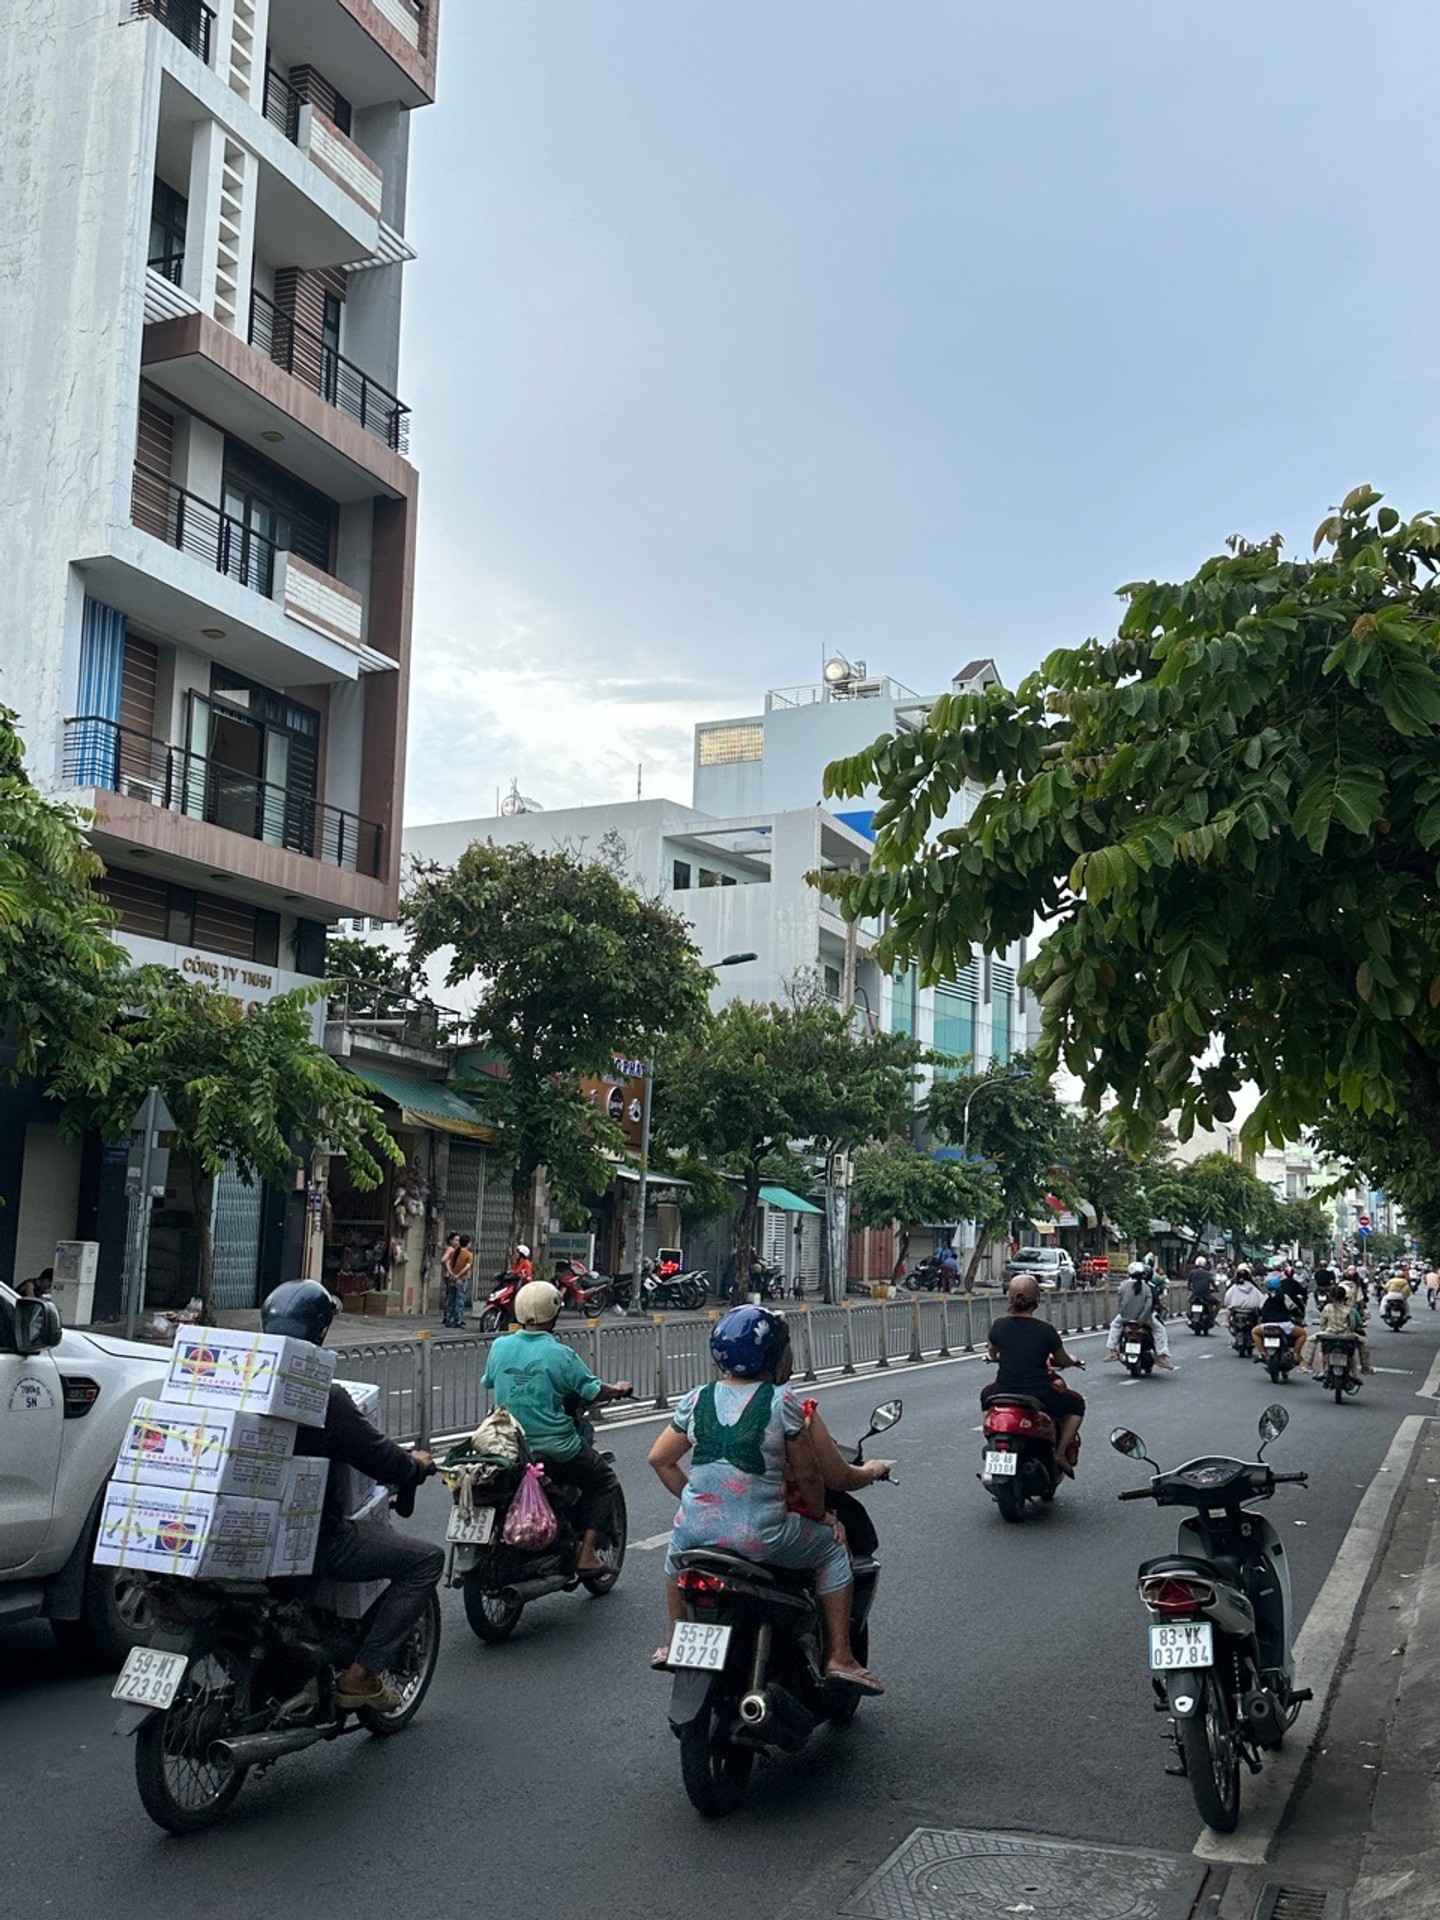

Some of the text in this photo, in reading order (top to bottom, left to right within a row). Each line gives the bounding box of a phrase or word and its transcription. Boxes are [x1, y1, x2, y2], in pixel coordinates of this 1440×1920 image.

[183, 955, 273, 990] CÔNG TY TNHH
[679, 1624, 724, 1646] 55-P7
[1159, 1626, 1202, 1646] 83-VK
[674, 1644, 719, 1666] 9279
[1153, 1646, 1209, 1666] 037.84
